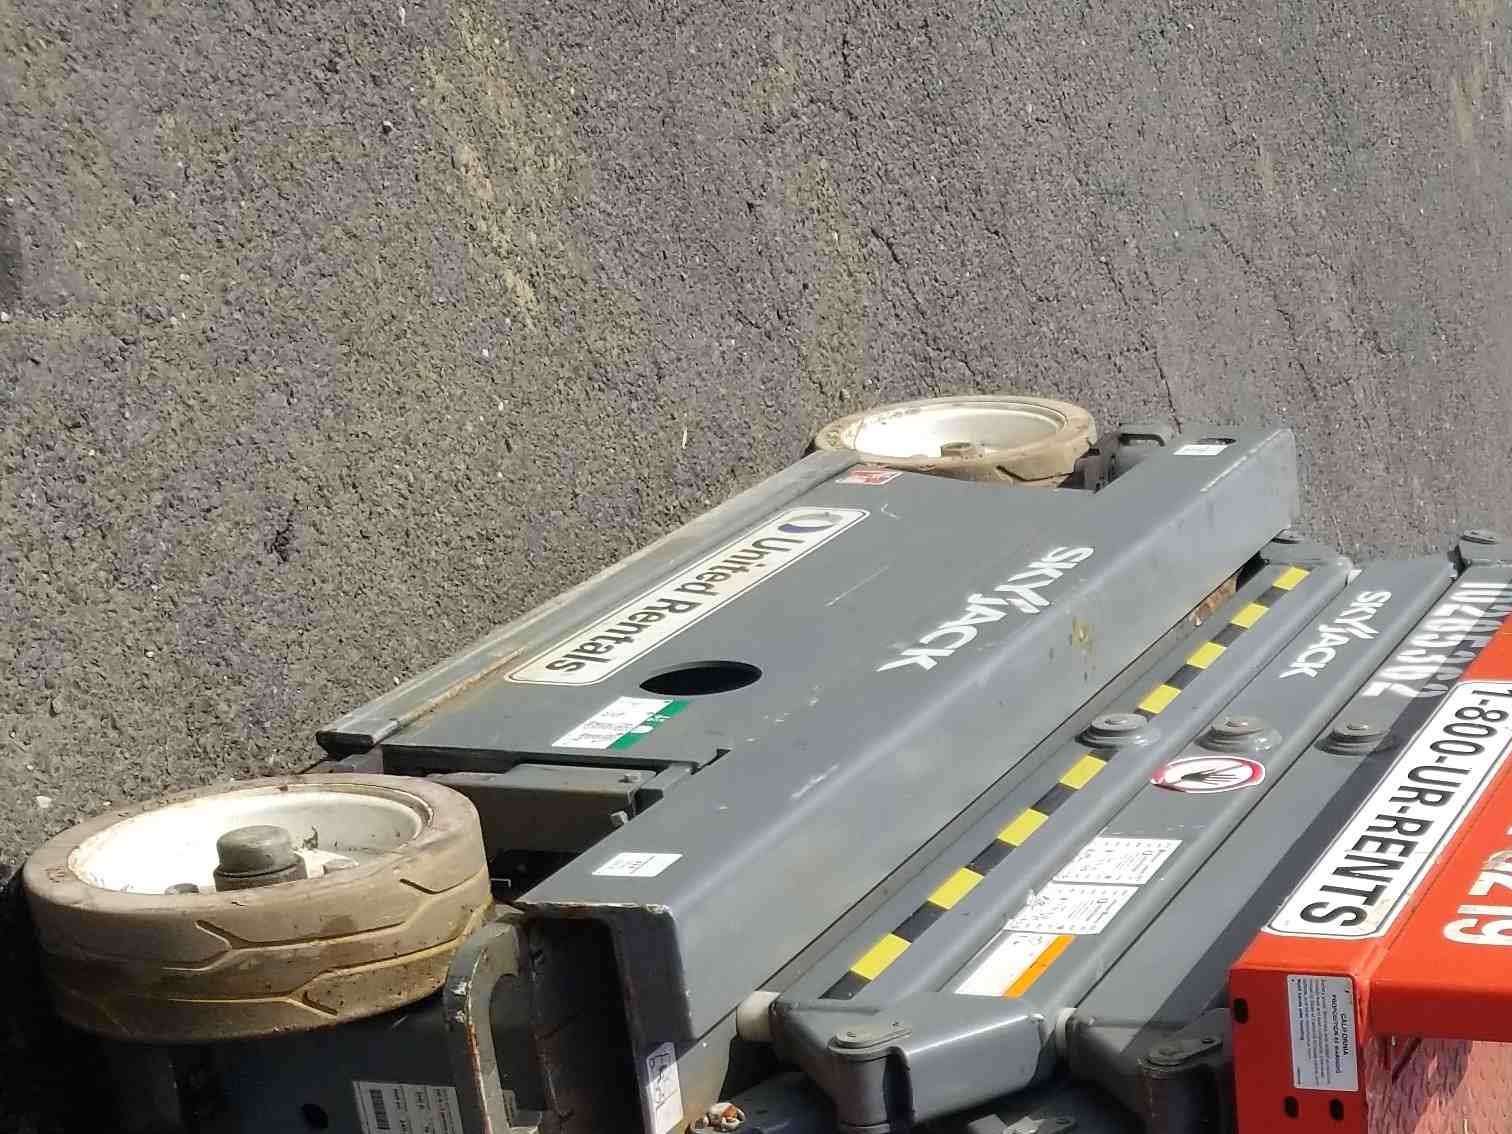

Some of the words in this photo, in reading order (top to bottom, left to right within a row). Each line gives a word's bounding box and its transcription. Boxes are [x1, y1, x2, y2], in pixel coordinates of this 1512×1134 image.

[674, 537, 805, 597] United
[544, 598, 702, 673] Rentals
[875, 546, 1094, 672] SKYJACK
[1278, 591, 1392, 680] SKYJACK
